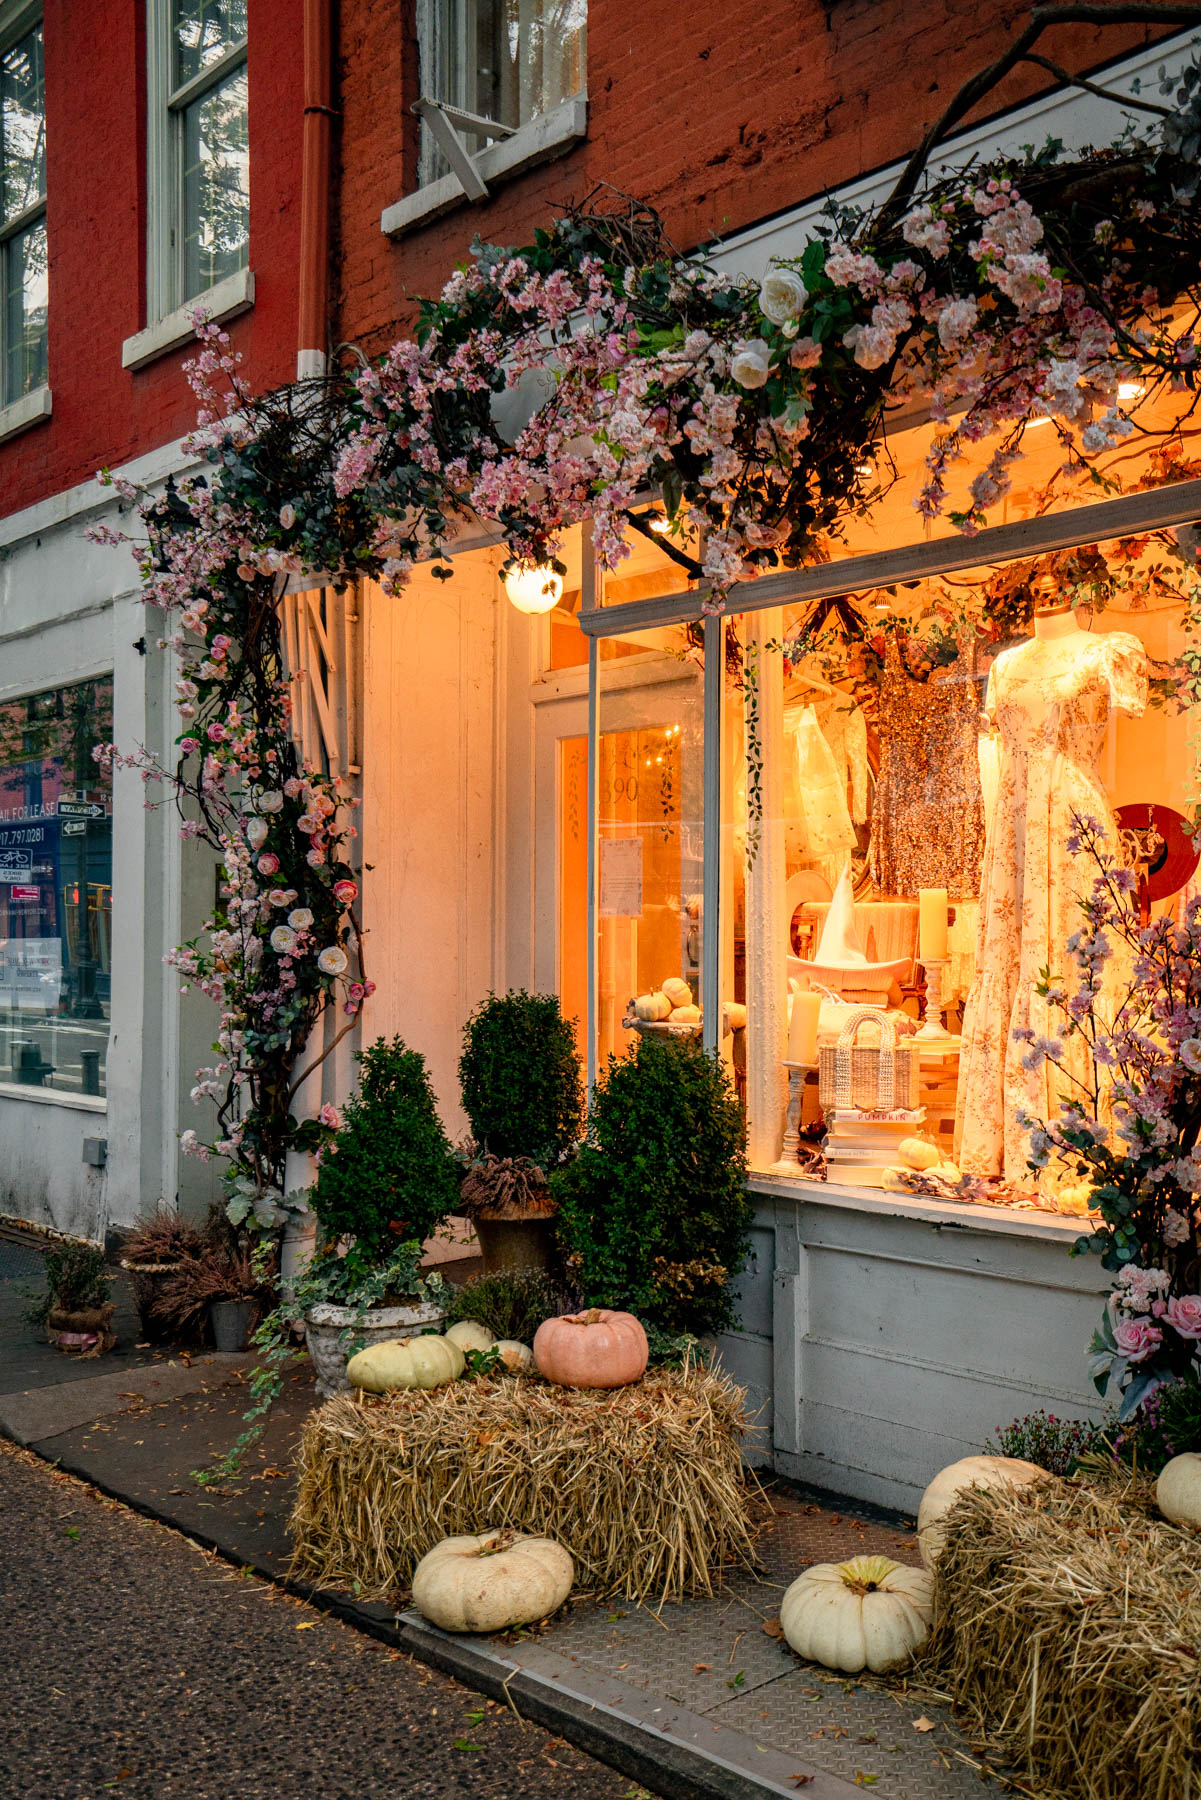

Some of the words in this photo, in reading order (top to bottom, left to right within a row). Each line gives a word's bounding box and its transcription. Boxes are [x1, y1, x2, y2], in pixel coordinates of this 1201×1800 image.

[12, 806, 28, 821] FOR
[30, 802, 55, 818] LEASE
[0, 828, 44, 845] 17.797.0281
